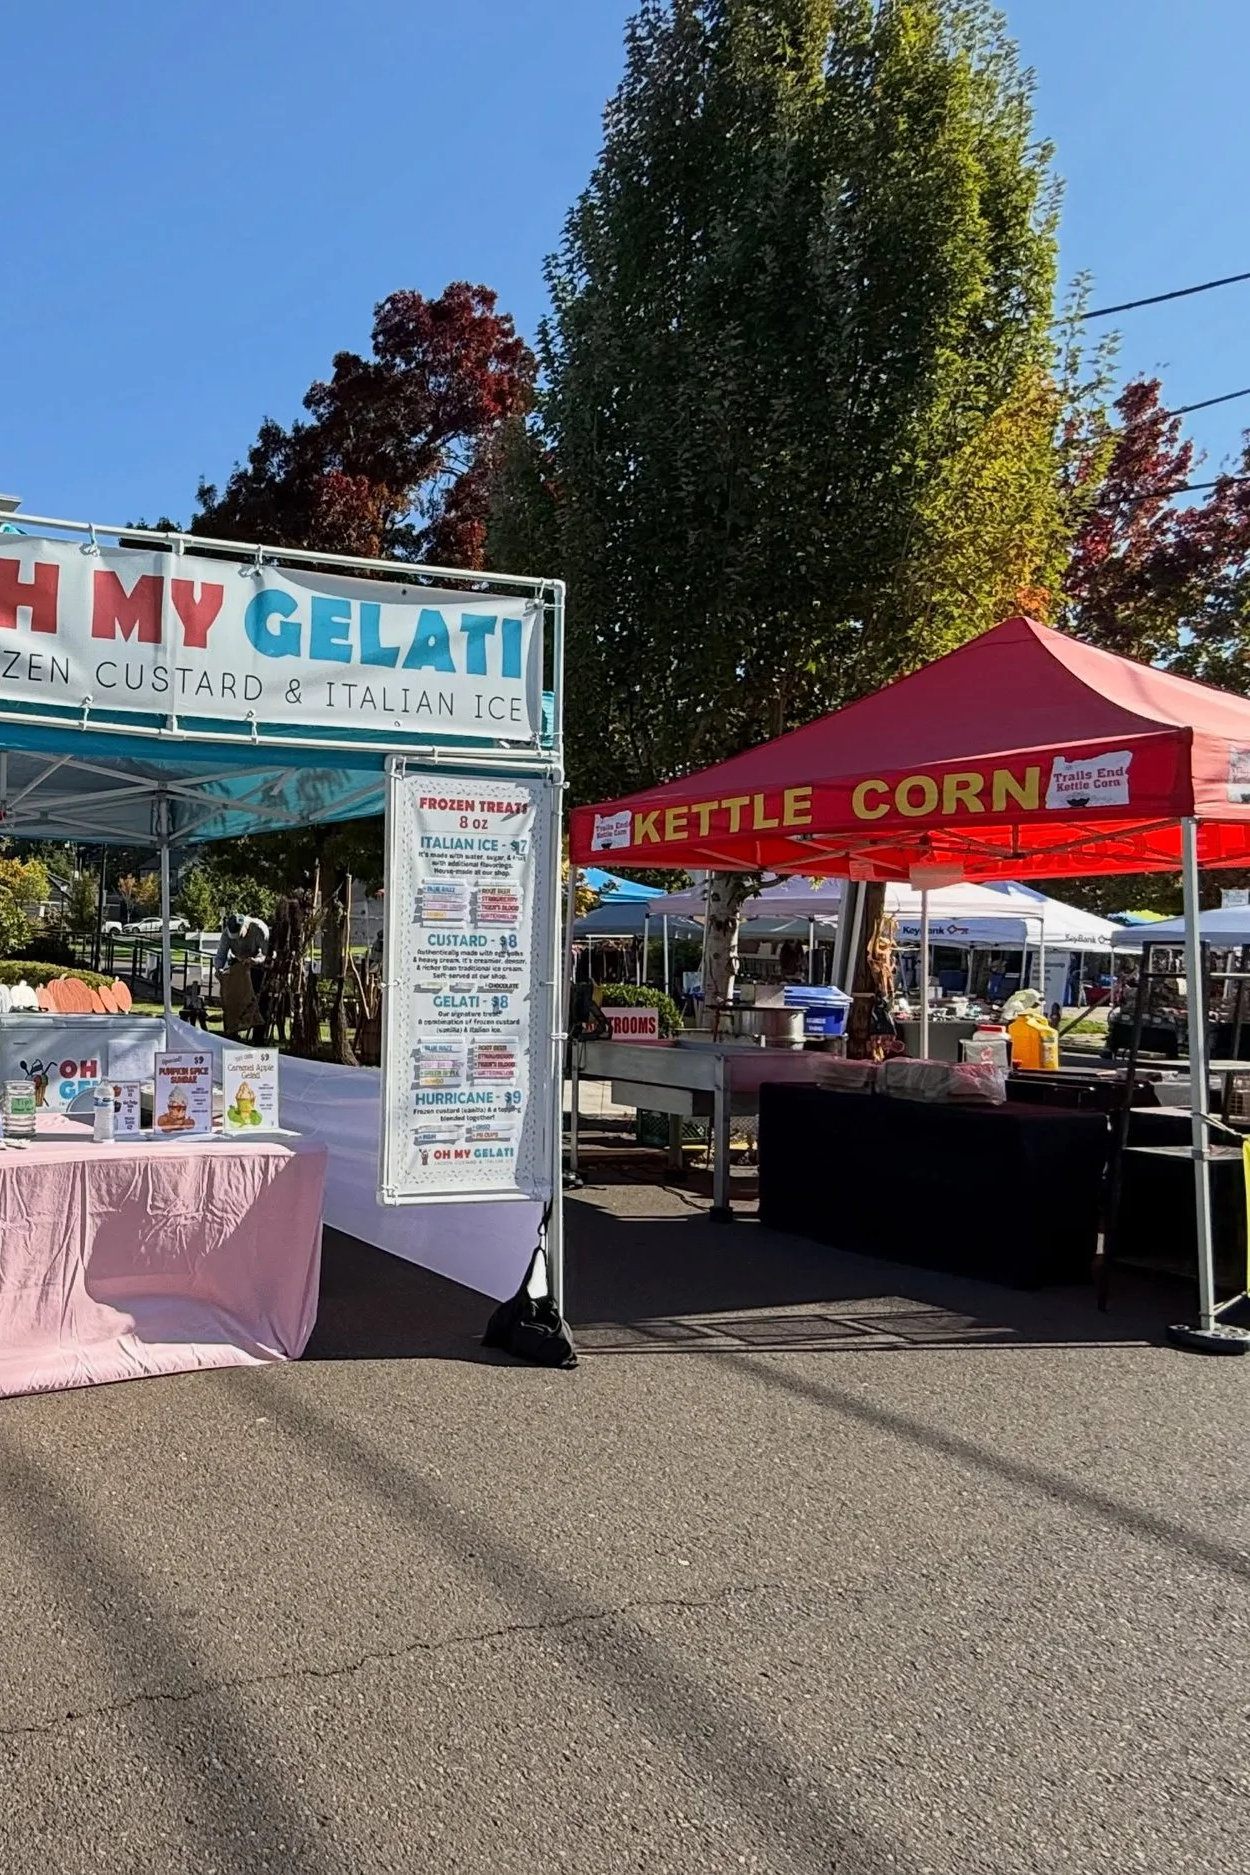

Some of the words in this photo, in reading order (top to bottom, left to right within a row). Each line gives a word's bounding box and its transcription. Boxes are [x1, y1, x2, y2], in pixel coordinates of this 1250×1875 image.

[91, 570, 224, 648] MY
[245, 589, 522, 678] GELATI
[96, 662, 262, 701] CUSTARD
[285, 679, 302, 704] &
[326, 682, 453, 716] ITALIAN
[475, 695, 521, 721] ICE
[1053, 769, 1092, 783] Trails
[1096, 766, 1125, 778] End
[1056, 780, 1090, 793] Kettle
[1094, 778, 1121, 789] Corn
[420, 798, 474, 812] FROZEN
[479, 801, 528, 814] TREATS
[634, 787, 812, 845] KETTLE
[852, 767, 1041, 820] CORN
[460, 816, 468, 829] 8
[596, 824, 614, 833] Trails
[616, 821, 628, 830] End
[614, 829, 627, 837] Corn
[420, 836, 474, 850] ITALIAN
[478, 839, 498, 851] ICE
[510, 840, 527, 852] $7
[903, 926, 944, 936] Keyank
[428, 934, 487, 947] CUSTARD
[499, 934, 517, 948] $8
[1065, 934, 1095, 944] KeyBank
[433, 996, 479, 1008] GELATI
[491, 995, 509, 1008] $8
[194, 1056, 204, 1064] $9
[260, 1053, 269, 1062] $9
[60, 1060, 97, 1078] OH
[415, 1092, 493, 1105] HURRICANE
[504, 1091, 521, 1104] $9
[434, 1150, 450, 1159] OH
[454, 1150, 471, 1159] MY
[474, 1148, 514, 1158] GELATI
